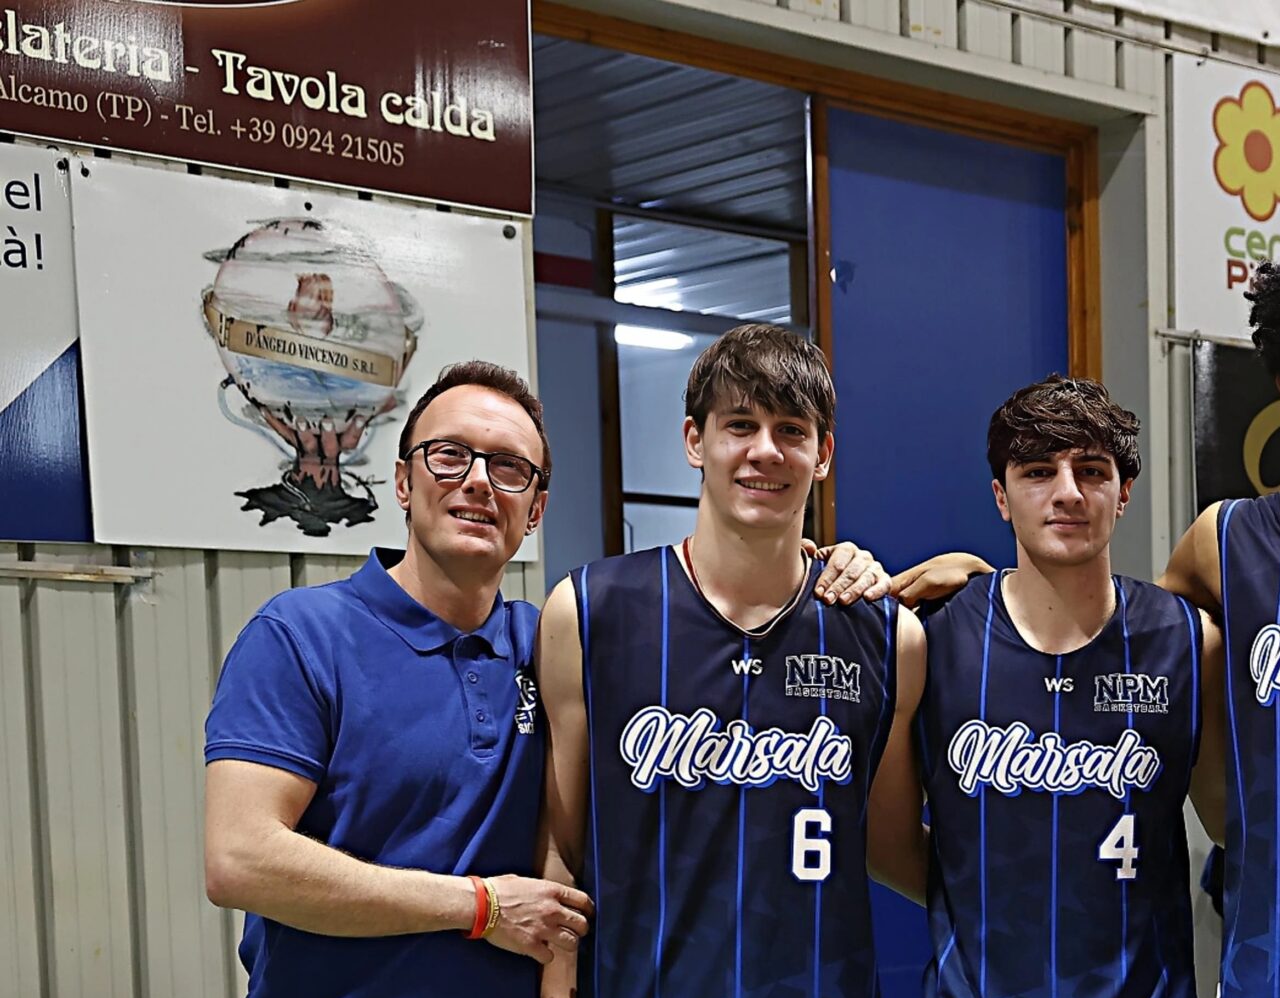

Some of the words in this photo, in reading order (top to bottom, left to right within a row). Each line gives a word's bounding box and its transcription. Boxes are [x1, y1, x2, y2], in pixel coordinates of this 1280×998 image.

[0, 9, 172, 82] lateria
[211, 49, 367, 118] Tavola
[380, 91, 496, 142] calda
[97, 91, 152, 127] (TP)
[175, 104, 222, 136] Tel.
[230, 117, 276, 144] +39
[282, 124, 335, 156] 0924
[341, 133, 405, 168] 21505
[4, 172, 42, 212] el
[0, 225, 43, 270] à!
[245, 331, 296, 356] D'ANGELO
[298, 344, 349, 369] VINCENZO
[732, 658, 763, 675] WS
[785, 654, 862, 694] NPM
[1044, 677, 1074, 693] WS
[785, 686, 862, 703] BASKETBALL
[1094, 673, 1169, 704] NPM
[1094, 703, 1169, 713] BASKETBALL
[619, 705, 853, 796] Marsala
[948, 719, 1163, 801] Marsala
[791, 808, 833, 881] 6
[1098, 813, 1139, 880] 4
